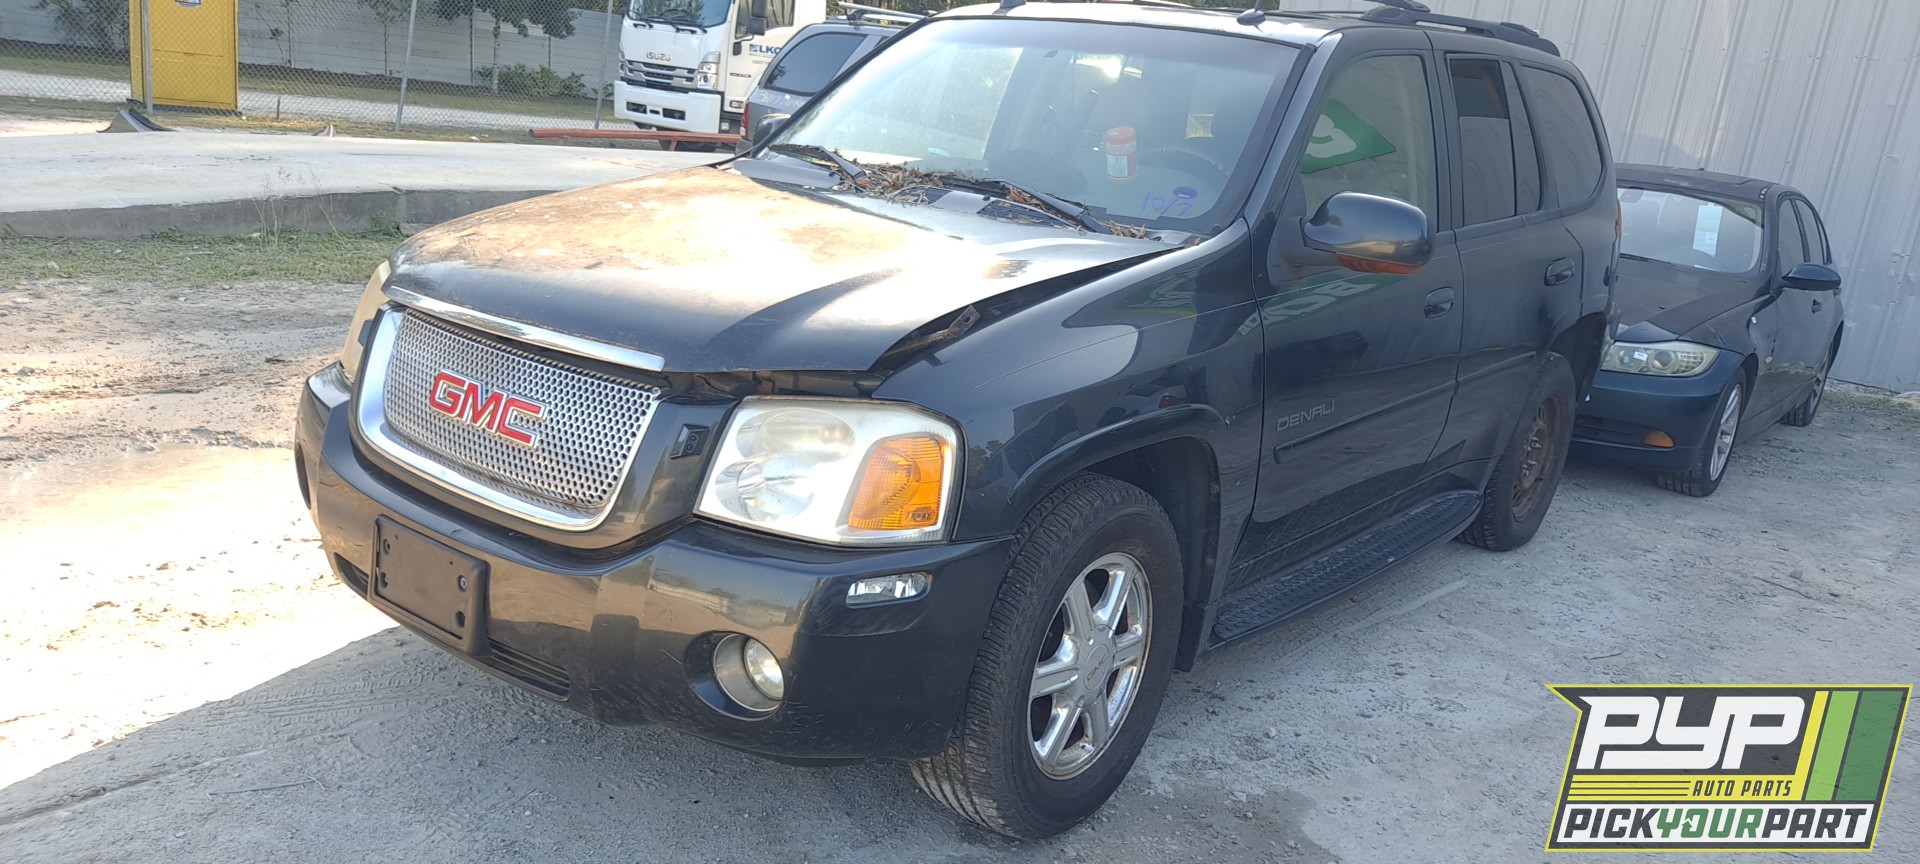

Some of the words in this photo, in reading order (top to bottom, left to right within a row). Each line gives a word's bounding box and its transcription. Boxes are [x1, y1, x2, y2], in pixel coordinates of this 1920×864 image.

[646, 51, 671, 62] ISUZU
[428, 369, 548, 448] GMC
[1276, 399, 1335, 432] DENALI
[1086, 652, 1108, 682] GMC
